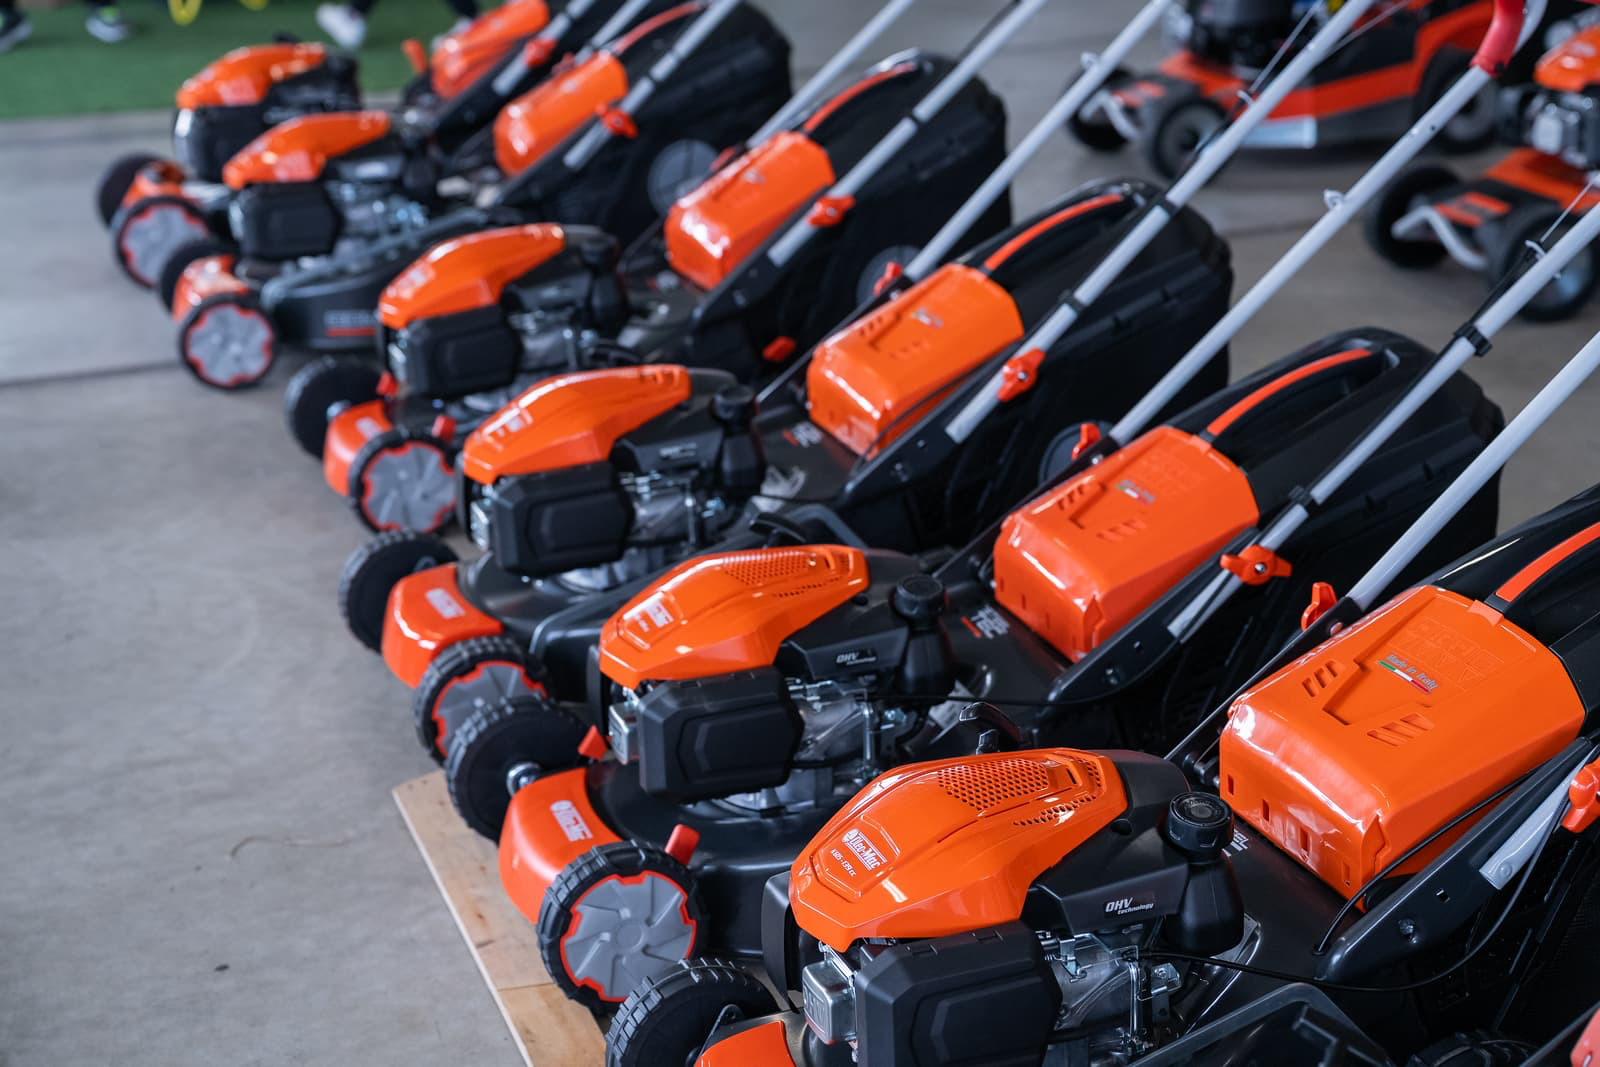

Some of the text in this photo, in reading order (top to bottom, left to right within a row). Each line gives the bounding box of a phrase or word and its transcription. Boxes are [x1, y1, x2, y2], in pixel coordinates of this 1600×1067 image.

[1417, 673, 1438, 691] Italy
[847, 833, 882, 869] Oleo-Mac
[1105, 897, 1154, 915] OHV technology
